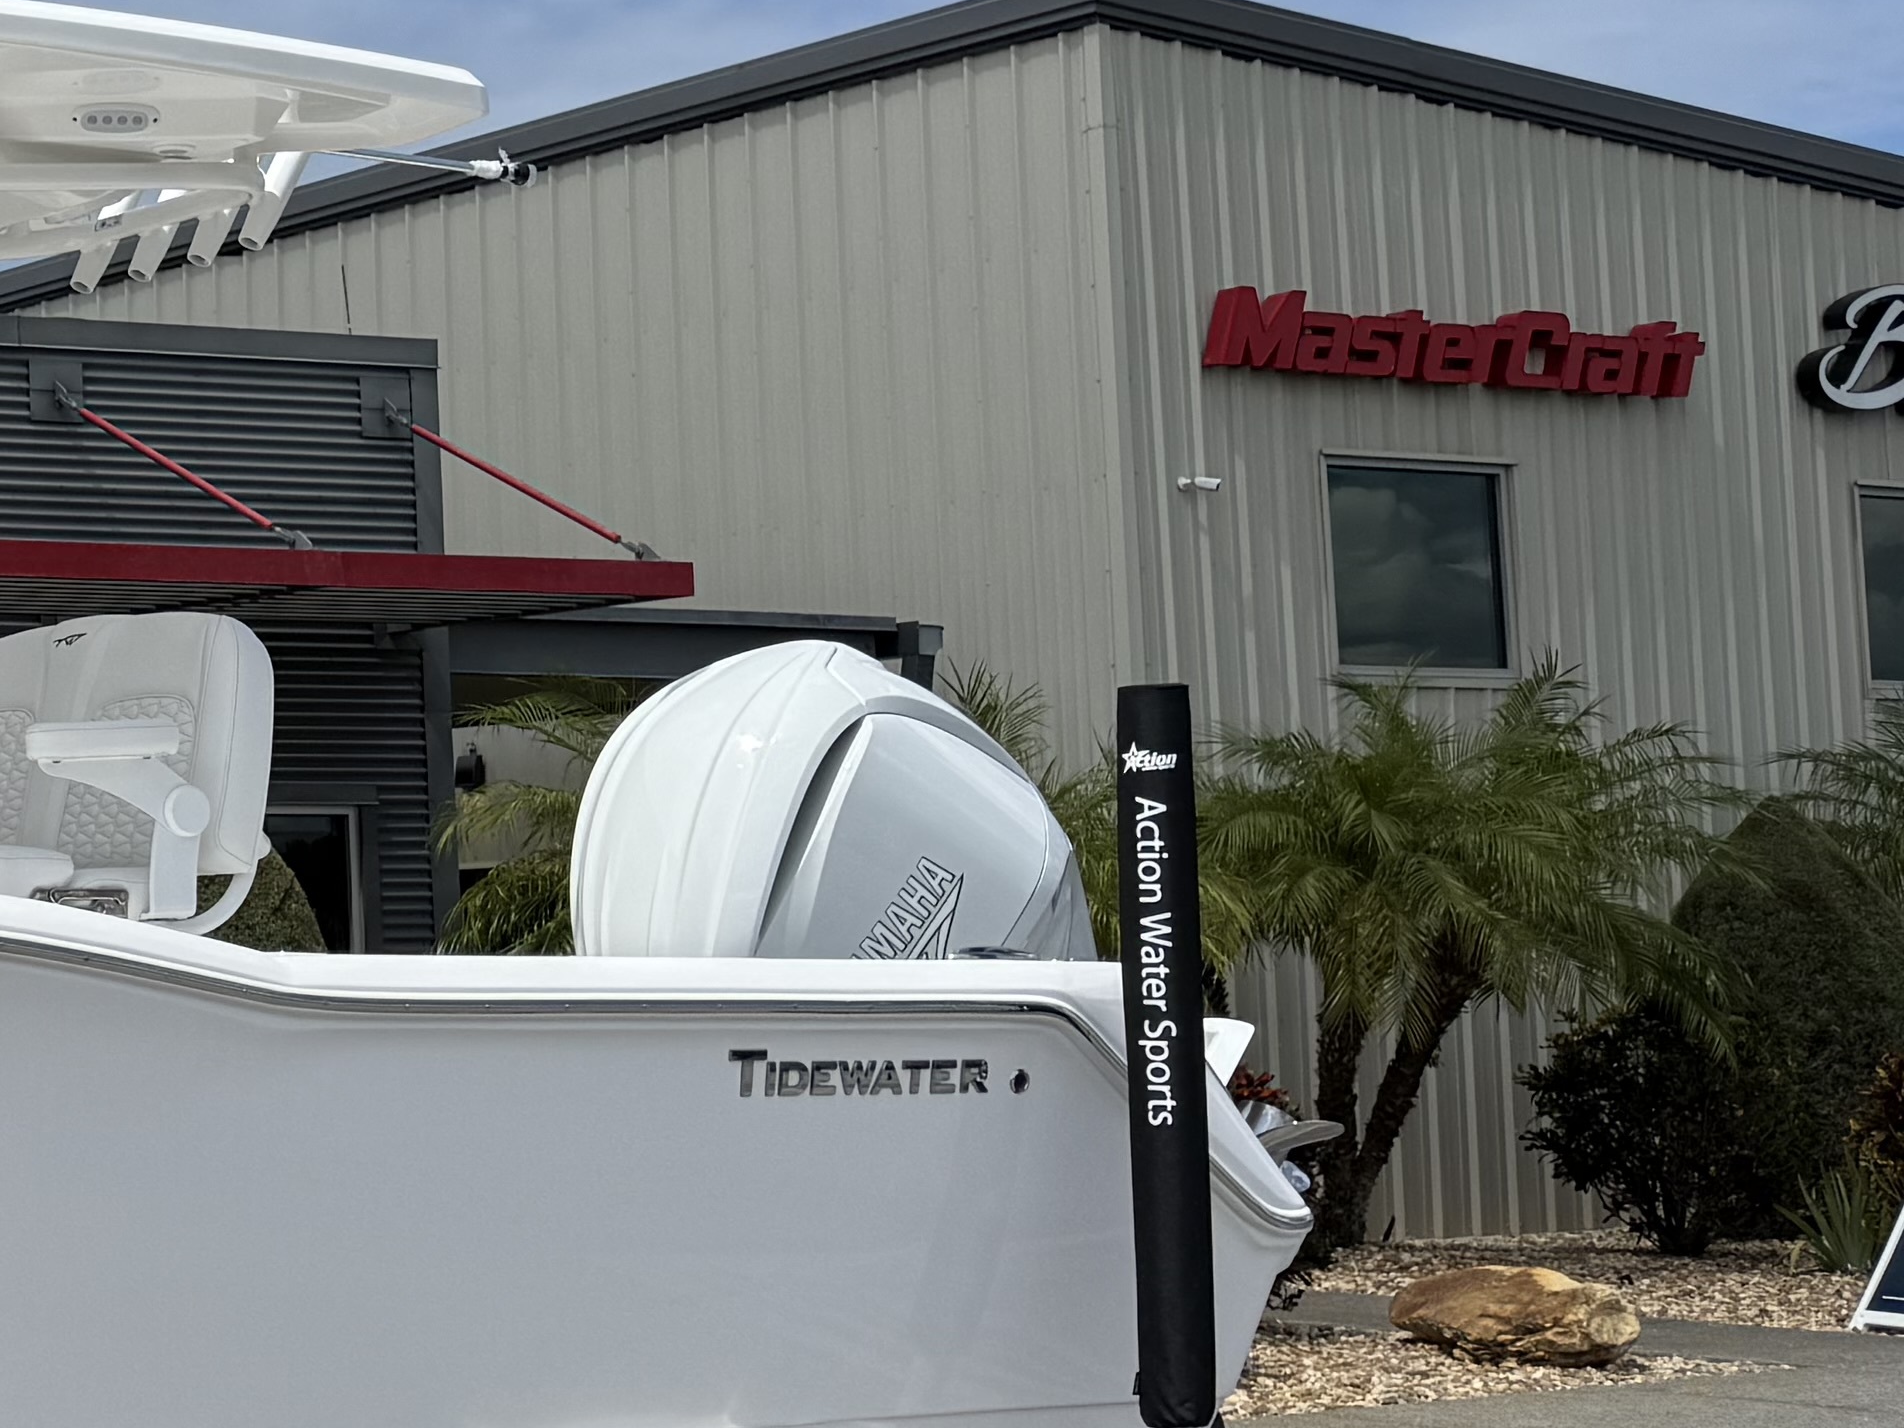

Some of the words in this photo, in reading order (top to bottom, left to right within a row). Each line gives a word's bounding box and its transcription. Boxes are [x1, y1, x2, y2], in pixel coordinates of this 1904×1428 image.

[1201, 285, 1706, 399] MasterCraft
[1134, 795, 1169, 904] Action
[849, 855, 956, 960] MAHA
[1139, 911, 1174, 1013] Water
[728, 1048, 989, 1098] TIDEWATER
[1137, 1018, 1178, 1127] Sports
